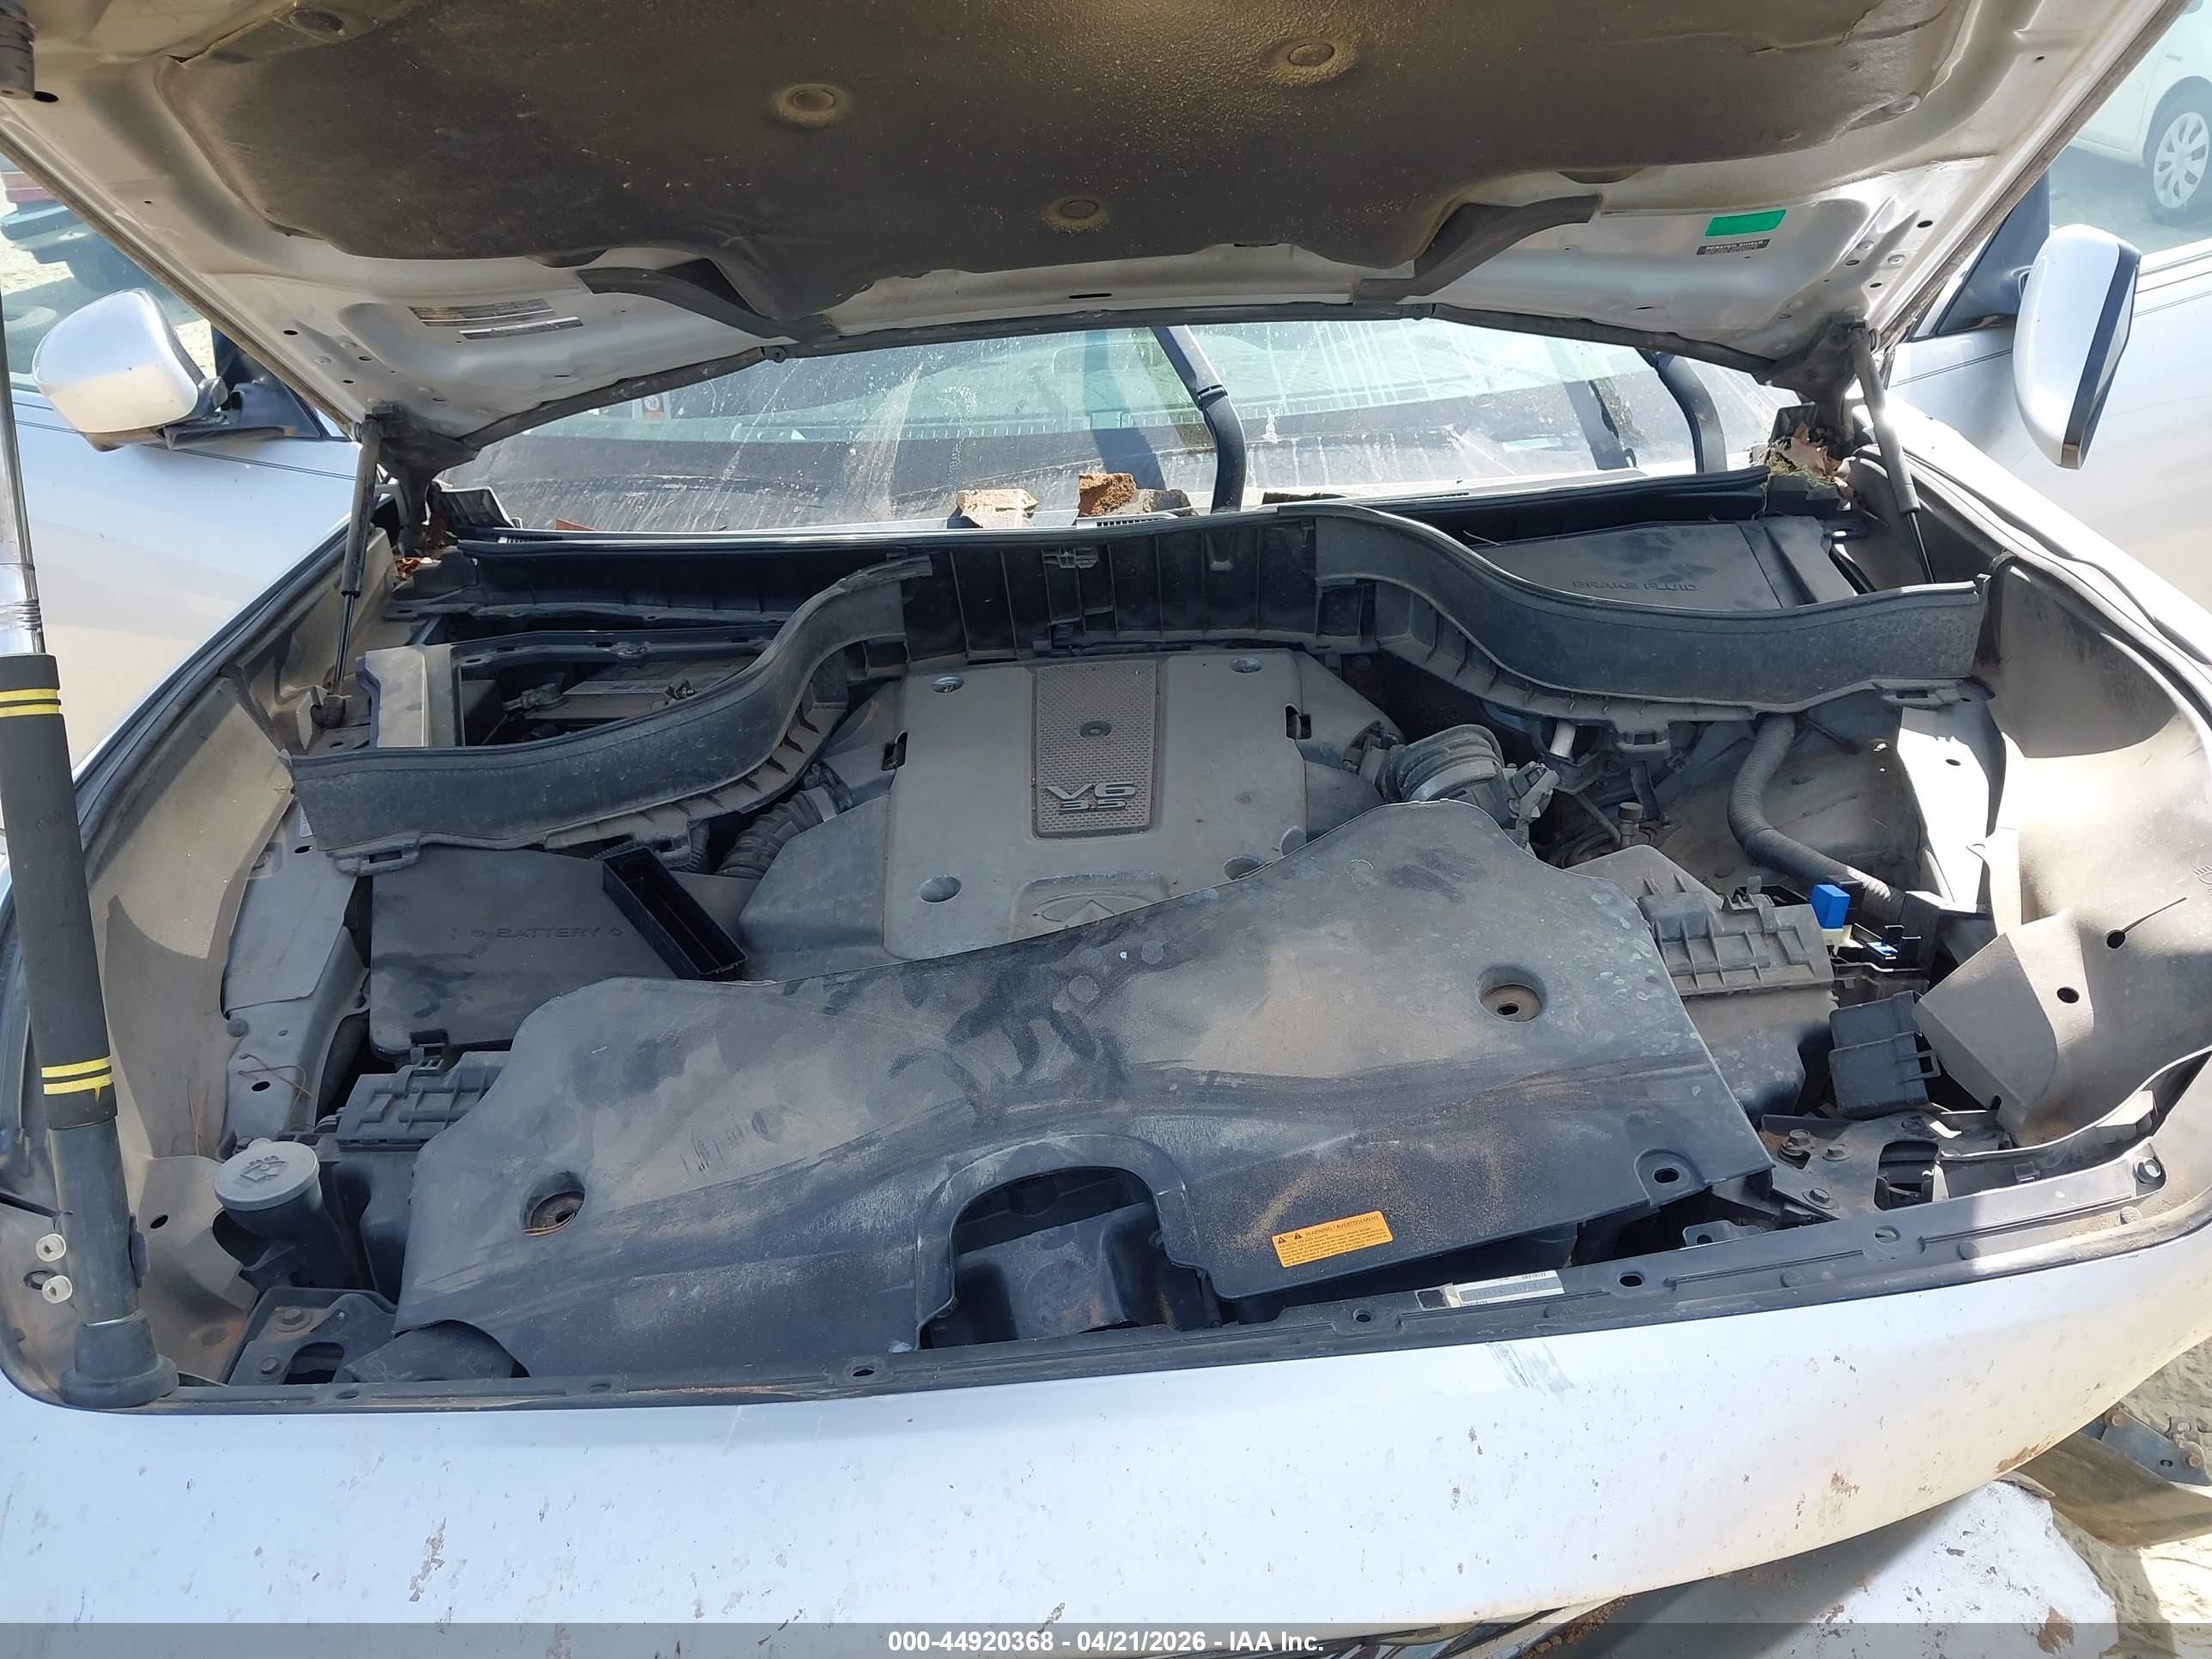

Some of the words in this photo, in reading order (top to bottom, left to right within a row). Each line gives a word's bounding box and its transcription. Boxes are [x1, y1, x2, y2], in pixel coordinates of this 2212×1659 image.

[1572, 580, 1639, 590] BRAKE
[1644, 582, 1697, 592] FLUID
[1047, 781, 1136, 800] V6
[1058, 798, 1127, 814] 3.5
[496, 927, 602, 939] BATTERY
[1305, 1225, 1333, 1237] WARNING
